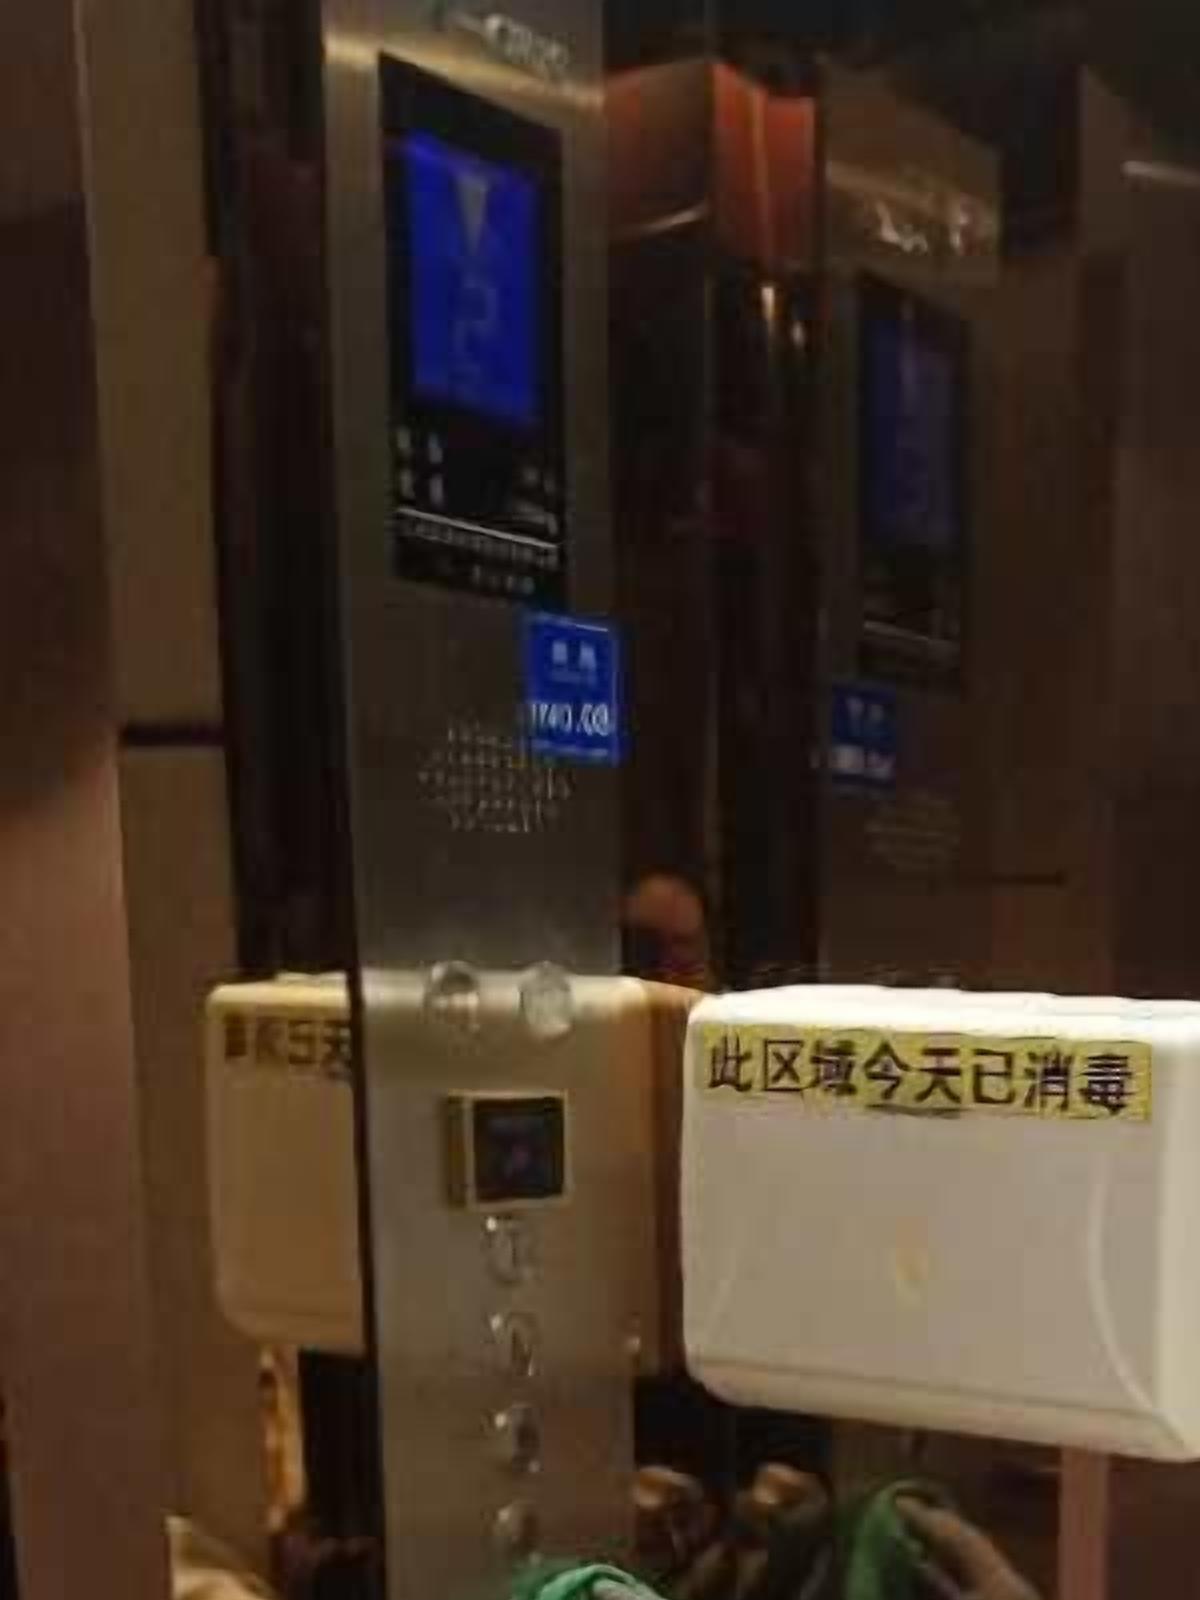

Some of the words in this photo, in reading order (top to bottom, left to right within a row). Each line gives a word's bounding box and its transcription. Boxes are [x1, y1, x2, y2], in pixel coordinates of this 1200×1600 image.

[707, 1034, 1134, 1115] 此区域今天已消毒
